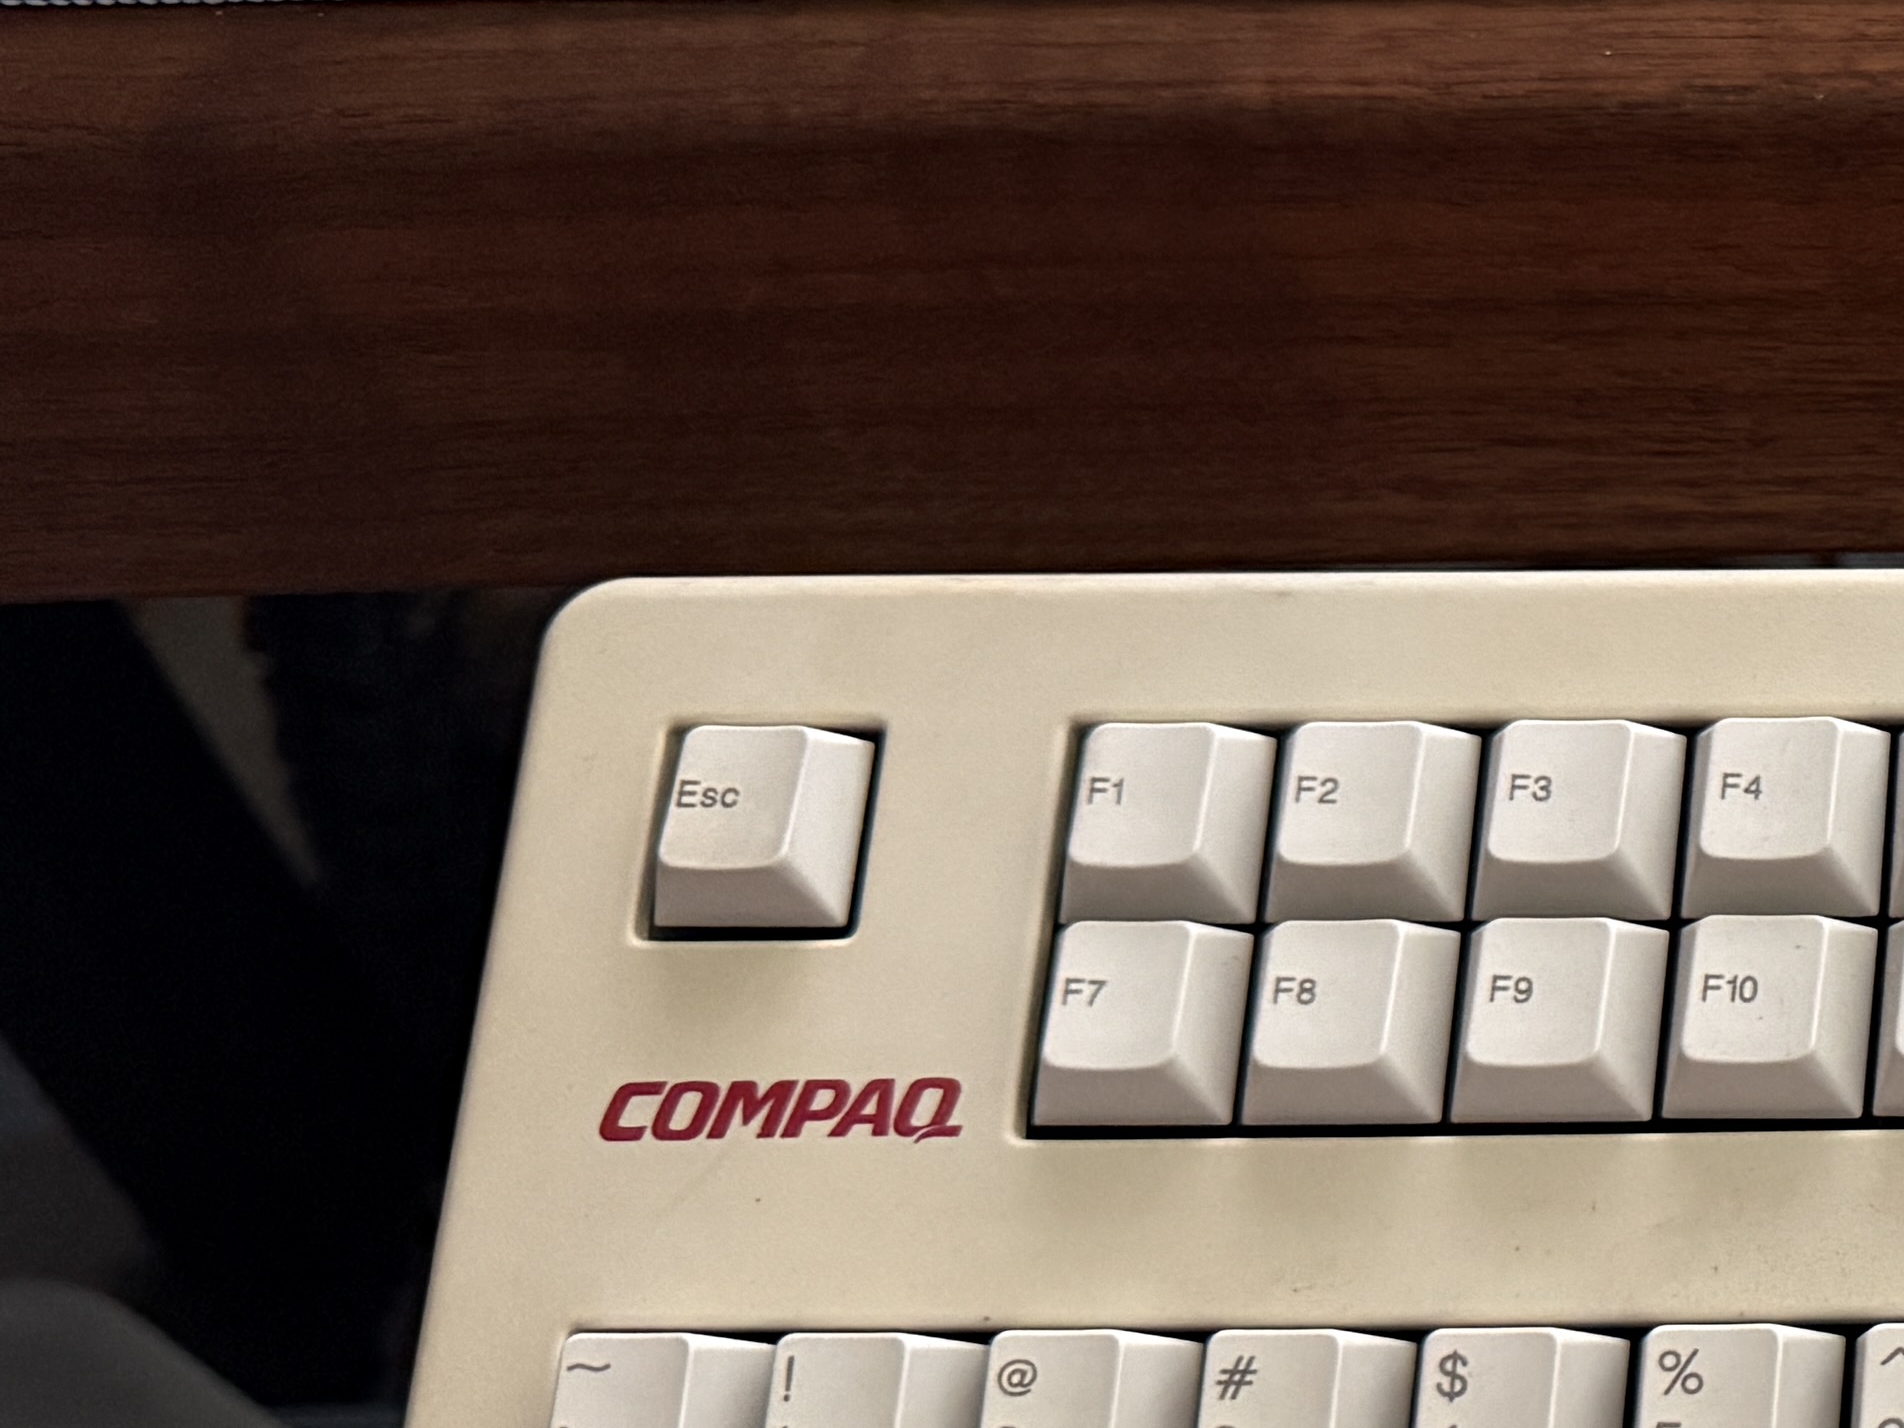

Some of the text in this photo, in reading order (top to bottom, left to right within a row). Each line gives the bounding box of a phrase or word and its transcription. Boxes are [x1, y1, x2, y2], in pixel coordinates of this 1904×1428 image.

[674, 779, 740, 809] Esc
[1087, 776, 1124, 806] F1
[1294, 775, 1339, 805] F2
[1508, 773, 1553, 803] F3
[1720, 771, 1763, 801] F4
[1061, 977, 1108, 1007] F7
[1272, 976, 1317, 1006] F8
[1488, 974, 1534, 1004] F9
[1701, 973, 1759, 1004] F10
[599, 1076, 963, 1144] COMPAQ
